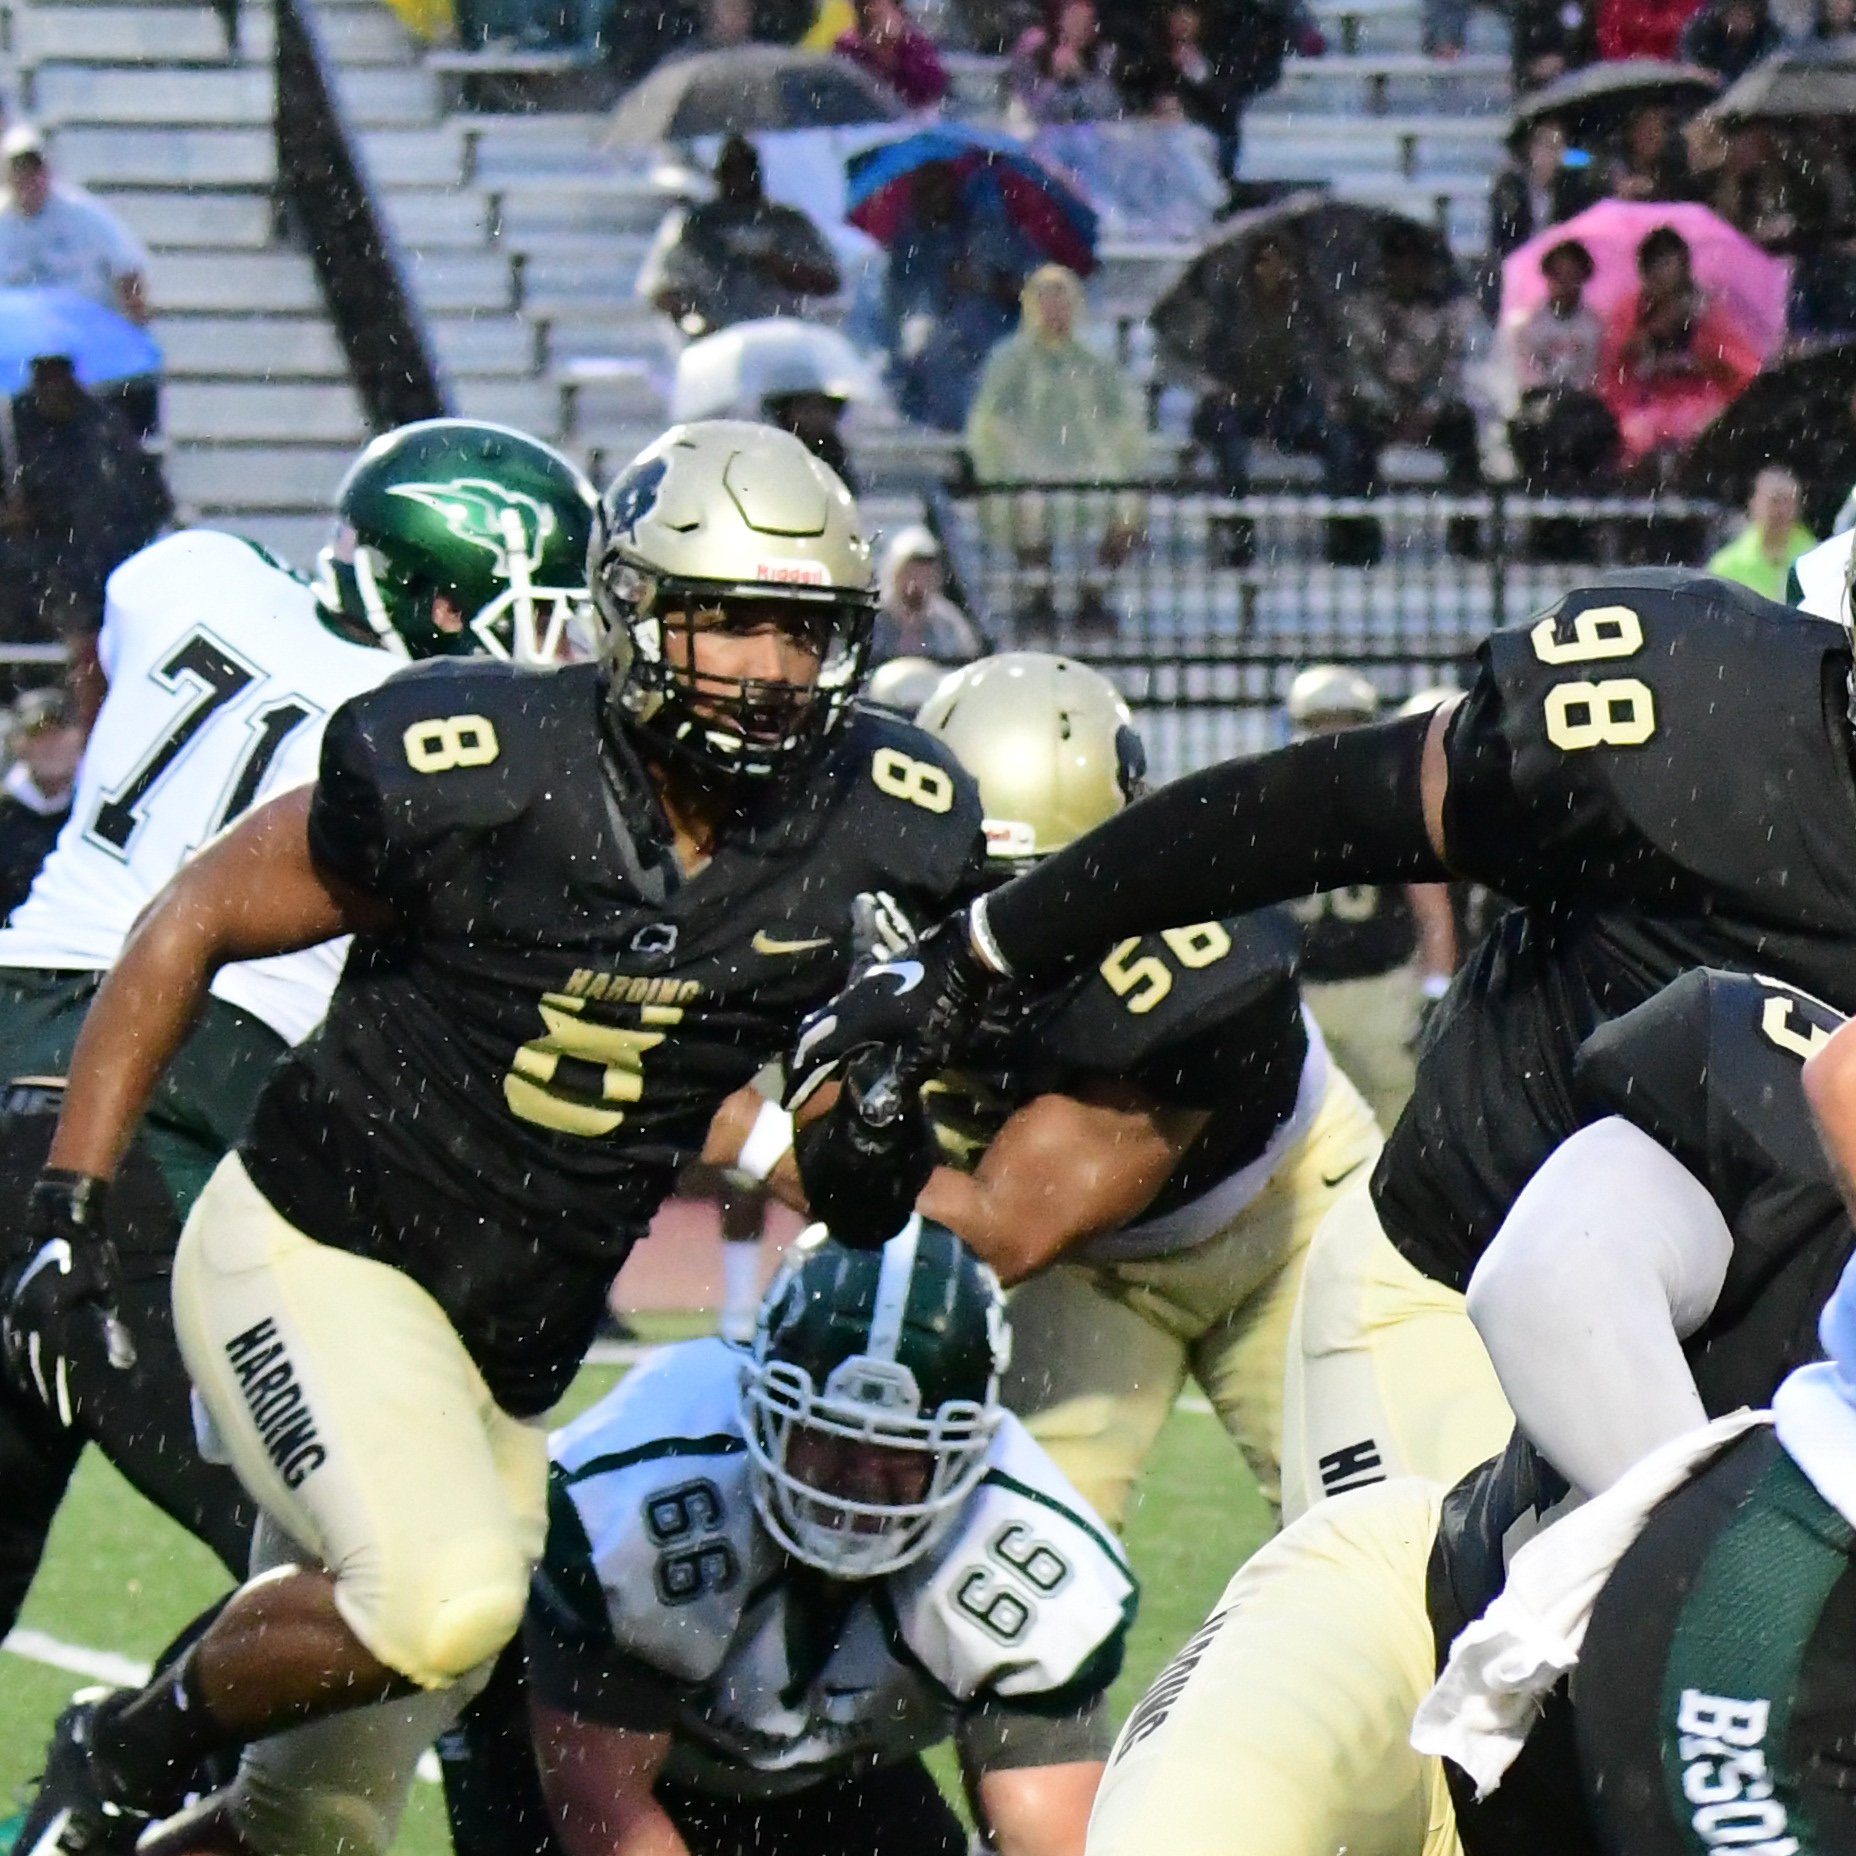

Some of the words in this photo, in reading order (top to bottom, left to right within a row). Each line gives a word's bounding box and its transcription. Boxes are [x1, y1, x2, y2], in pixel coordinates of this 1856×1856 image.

[82, 622, 327, 866] 71
[403, 714, 499, 774] 8
[1530, 605, 1656, 751] 98
[871, 746, 954, 813] 8
[562, 967, 704, 1005] HARDING
[502, 991, 684, 1138] 8
[225, 1316, 328, 1491] HARDING
[645, 1477, 740, 1607] 66
[946, 1516, 1074, 1648] 66
